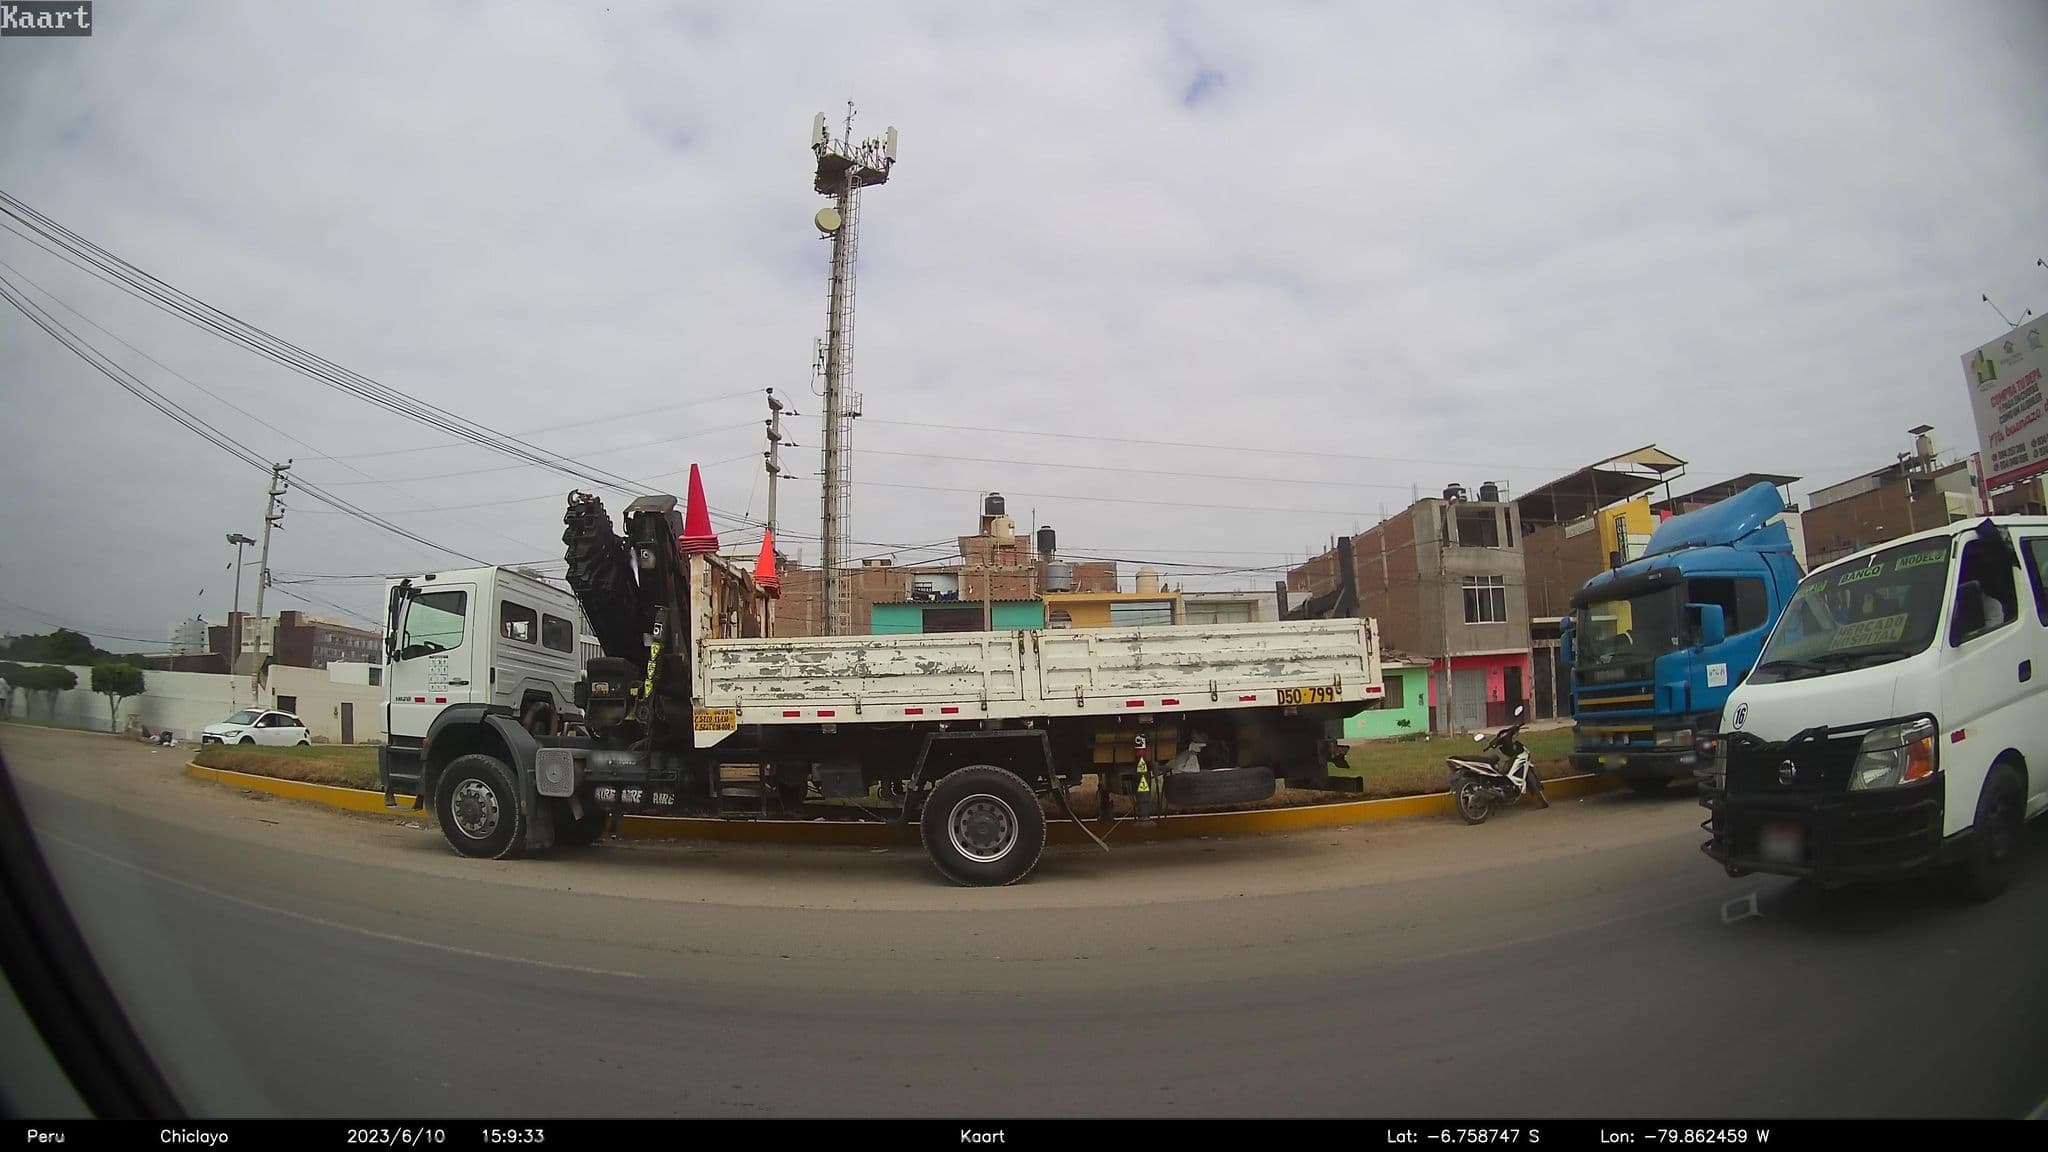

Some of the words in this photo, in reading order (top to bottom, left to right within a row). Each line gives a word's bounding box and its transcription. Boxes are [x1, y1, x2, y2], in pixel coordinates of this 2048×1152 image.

[1899, 553, 1942, 567] MODELO
[1840, 565, 1881, 583] BANCO
[1734, 707, 1746, 725] 16
[653, 792, 675, 805] AIRE
